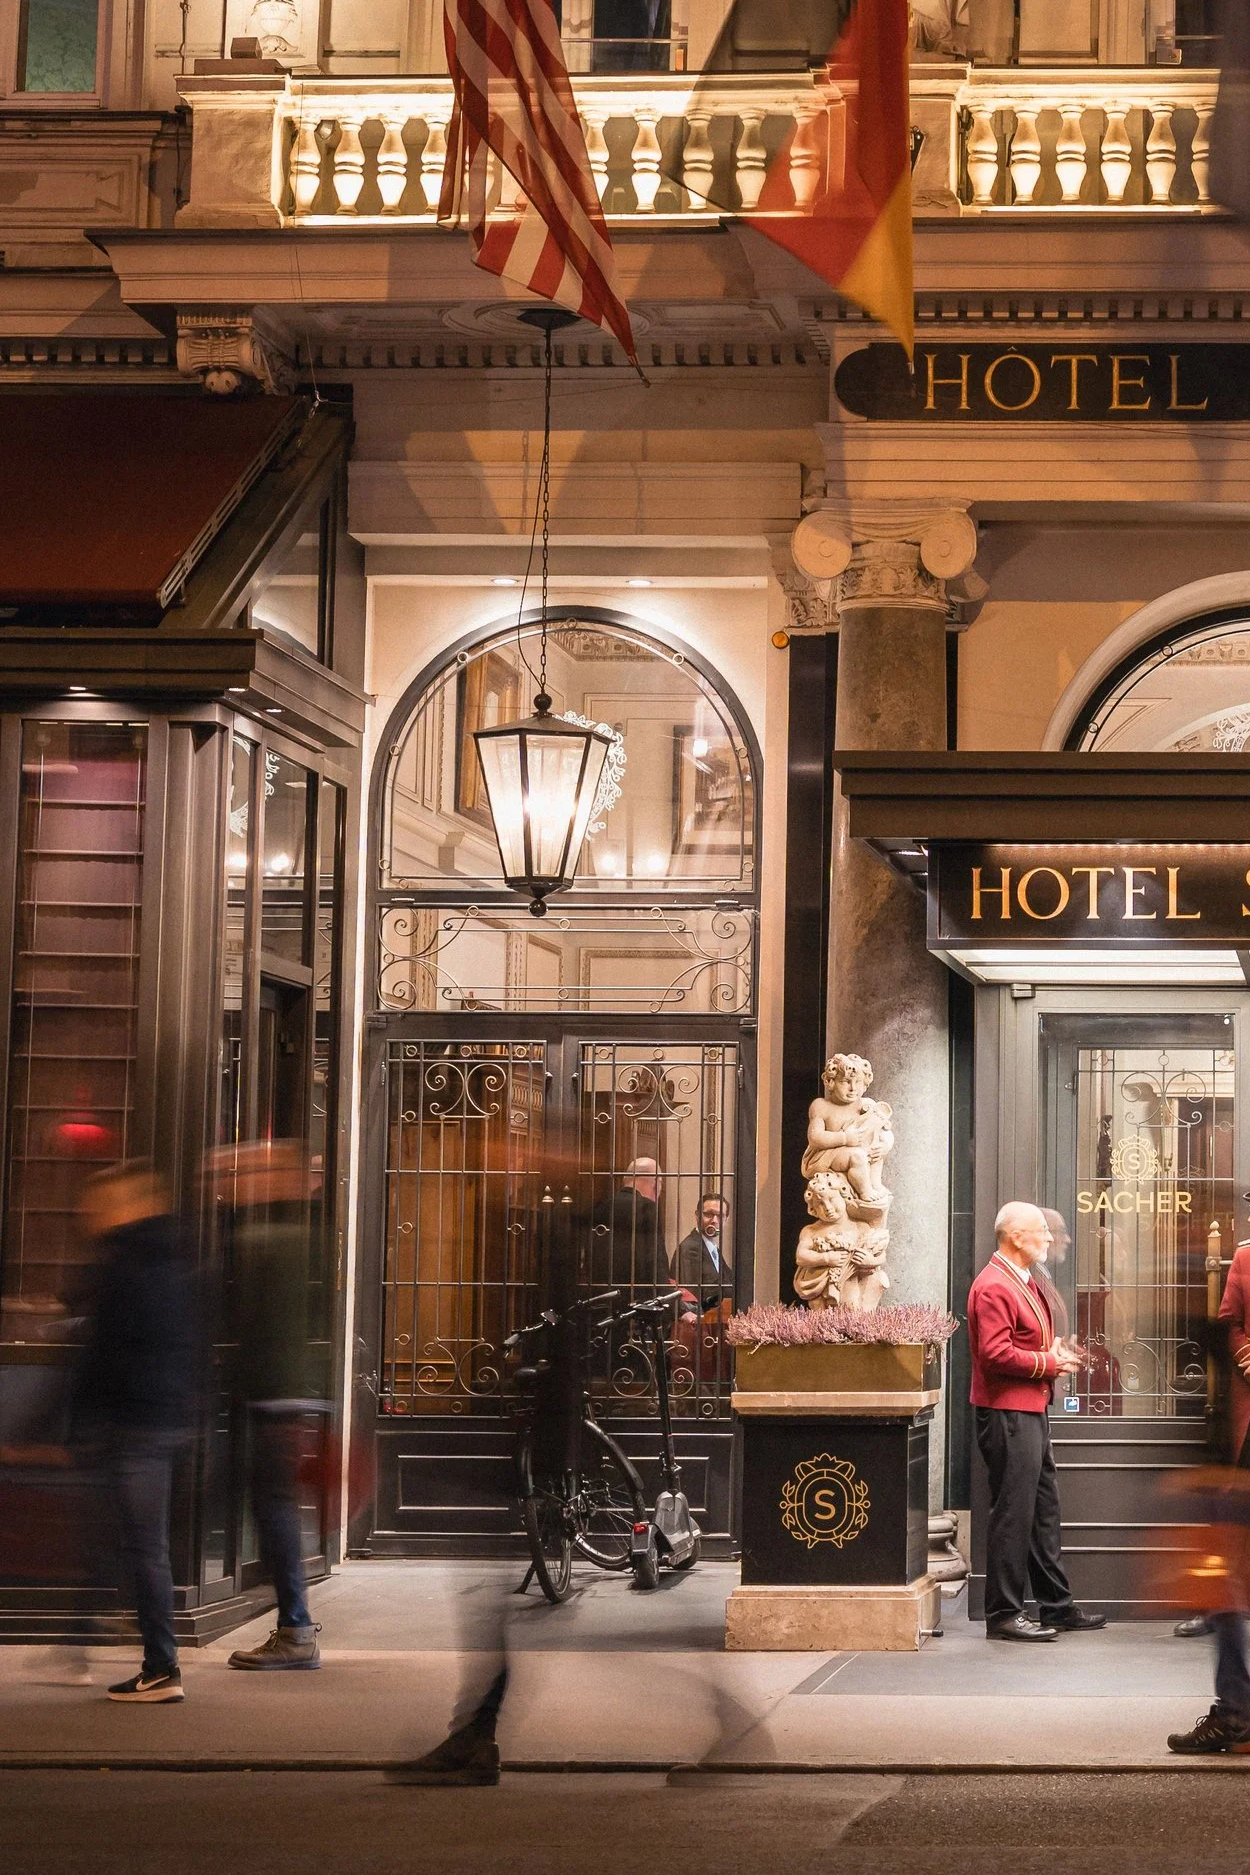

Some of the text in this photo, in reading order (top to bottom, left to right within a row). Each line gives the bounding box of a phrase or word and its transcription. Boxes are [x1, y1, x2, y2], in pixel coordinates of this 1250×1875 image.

[970, 866, 1201, 920] HOTEL
[1128, 1153, 1141, 1170] S
[1077, 1191, 1193, 1213] SACHER
[814, 1489, 836, 1520] S
